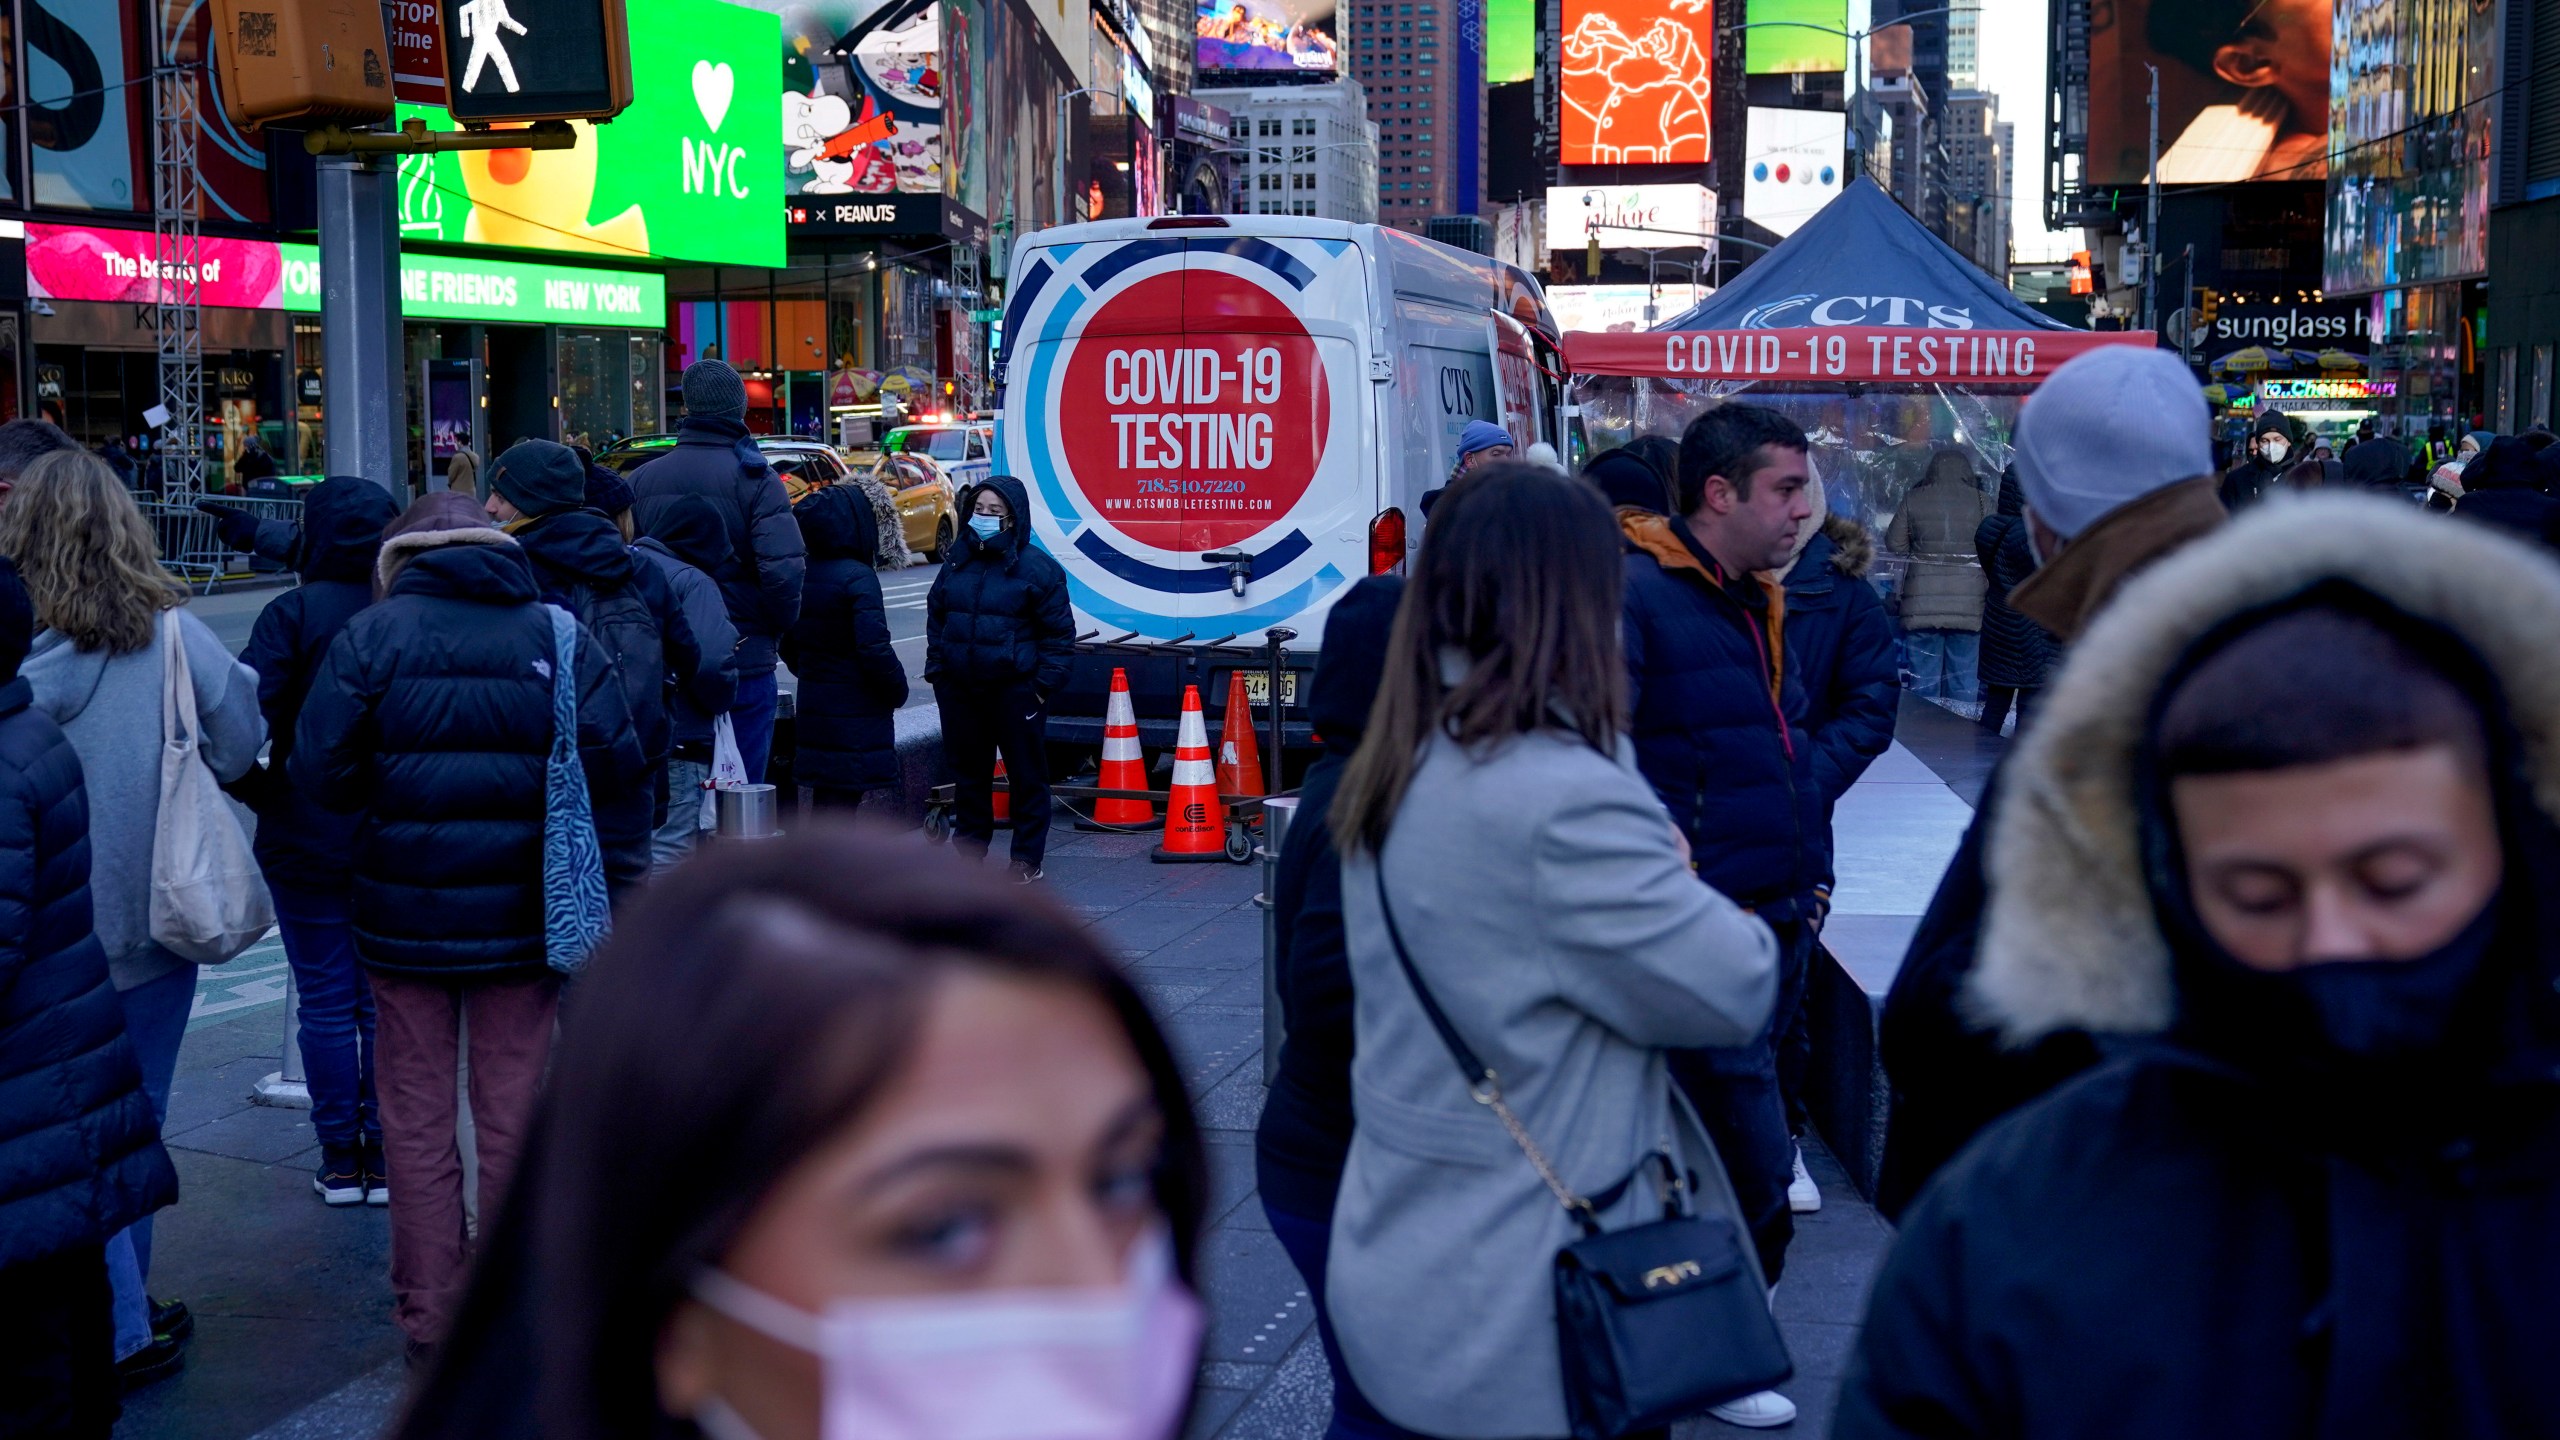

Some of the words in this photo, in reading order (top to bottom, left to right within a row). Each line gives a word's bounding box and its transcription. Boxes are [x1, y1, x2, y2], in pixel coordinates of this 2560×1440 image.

[682, 136, 749, 199] NYC
[835, 204, 895, 223] PEANUTS
[102, 252, 137, 278] The
[202, 258, 221, 282] of
[431, 270, 518, 307] FRIENDS
[544, 279, 590, 310] NEW
[592, 283, 642, 314] YORK
[1811, 296, 1974, 330] CTS
[2216, 308, 2347, 346] sunglass
[1105, 347, 1282, 405] COVID-19
[1666, 335, 1847, 376] COVID-19
[1867, 336, 2036, 377] TESTING
[1440, 366, 1474, 416] CTS
[1110, 412, 1273, 470] TESTING
[1105, 498, 1272, 510] WWW.CTSMOBILETESTING.COM
[1137, 477, 1246, 494] 718.540.7220
